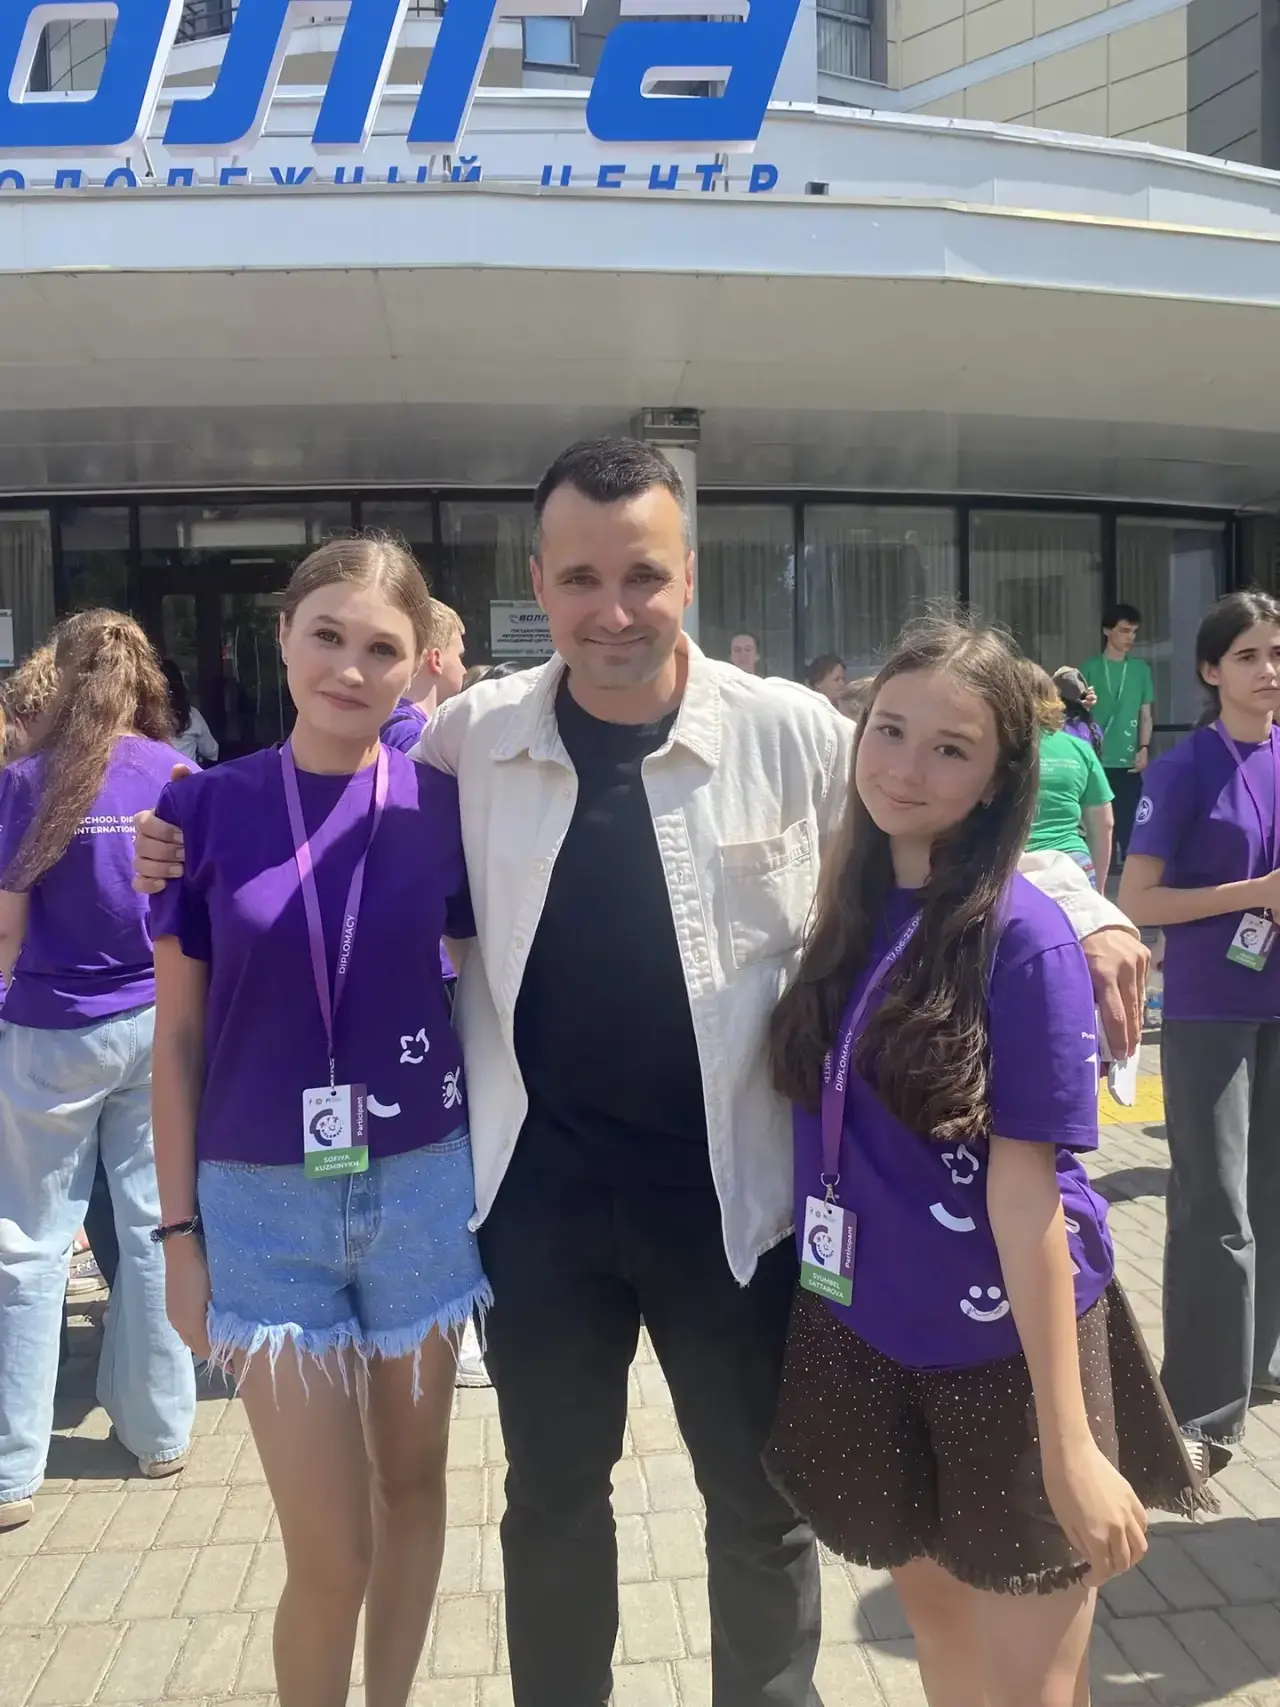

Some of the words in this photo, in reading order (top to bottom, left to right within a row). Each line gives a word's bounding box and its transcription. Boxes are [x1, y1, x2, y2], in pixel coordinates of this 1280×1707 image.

[519, 614, 549, 622] ВОЛГ
[79, 815, 119, 825] SCHOOL
[74, 826, 137, 835] INTERNATION
[338, 914, 356, 974] DIPLOMACY
[835, 1028, 853, 1092] DIPLOMACY
[323, 1154, 350, 1163] SOFIYA
[845, 1226, 853, 1268] Participant
